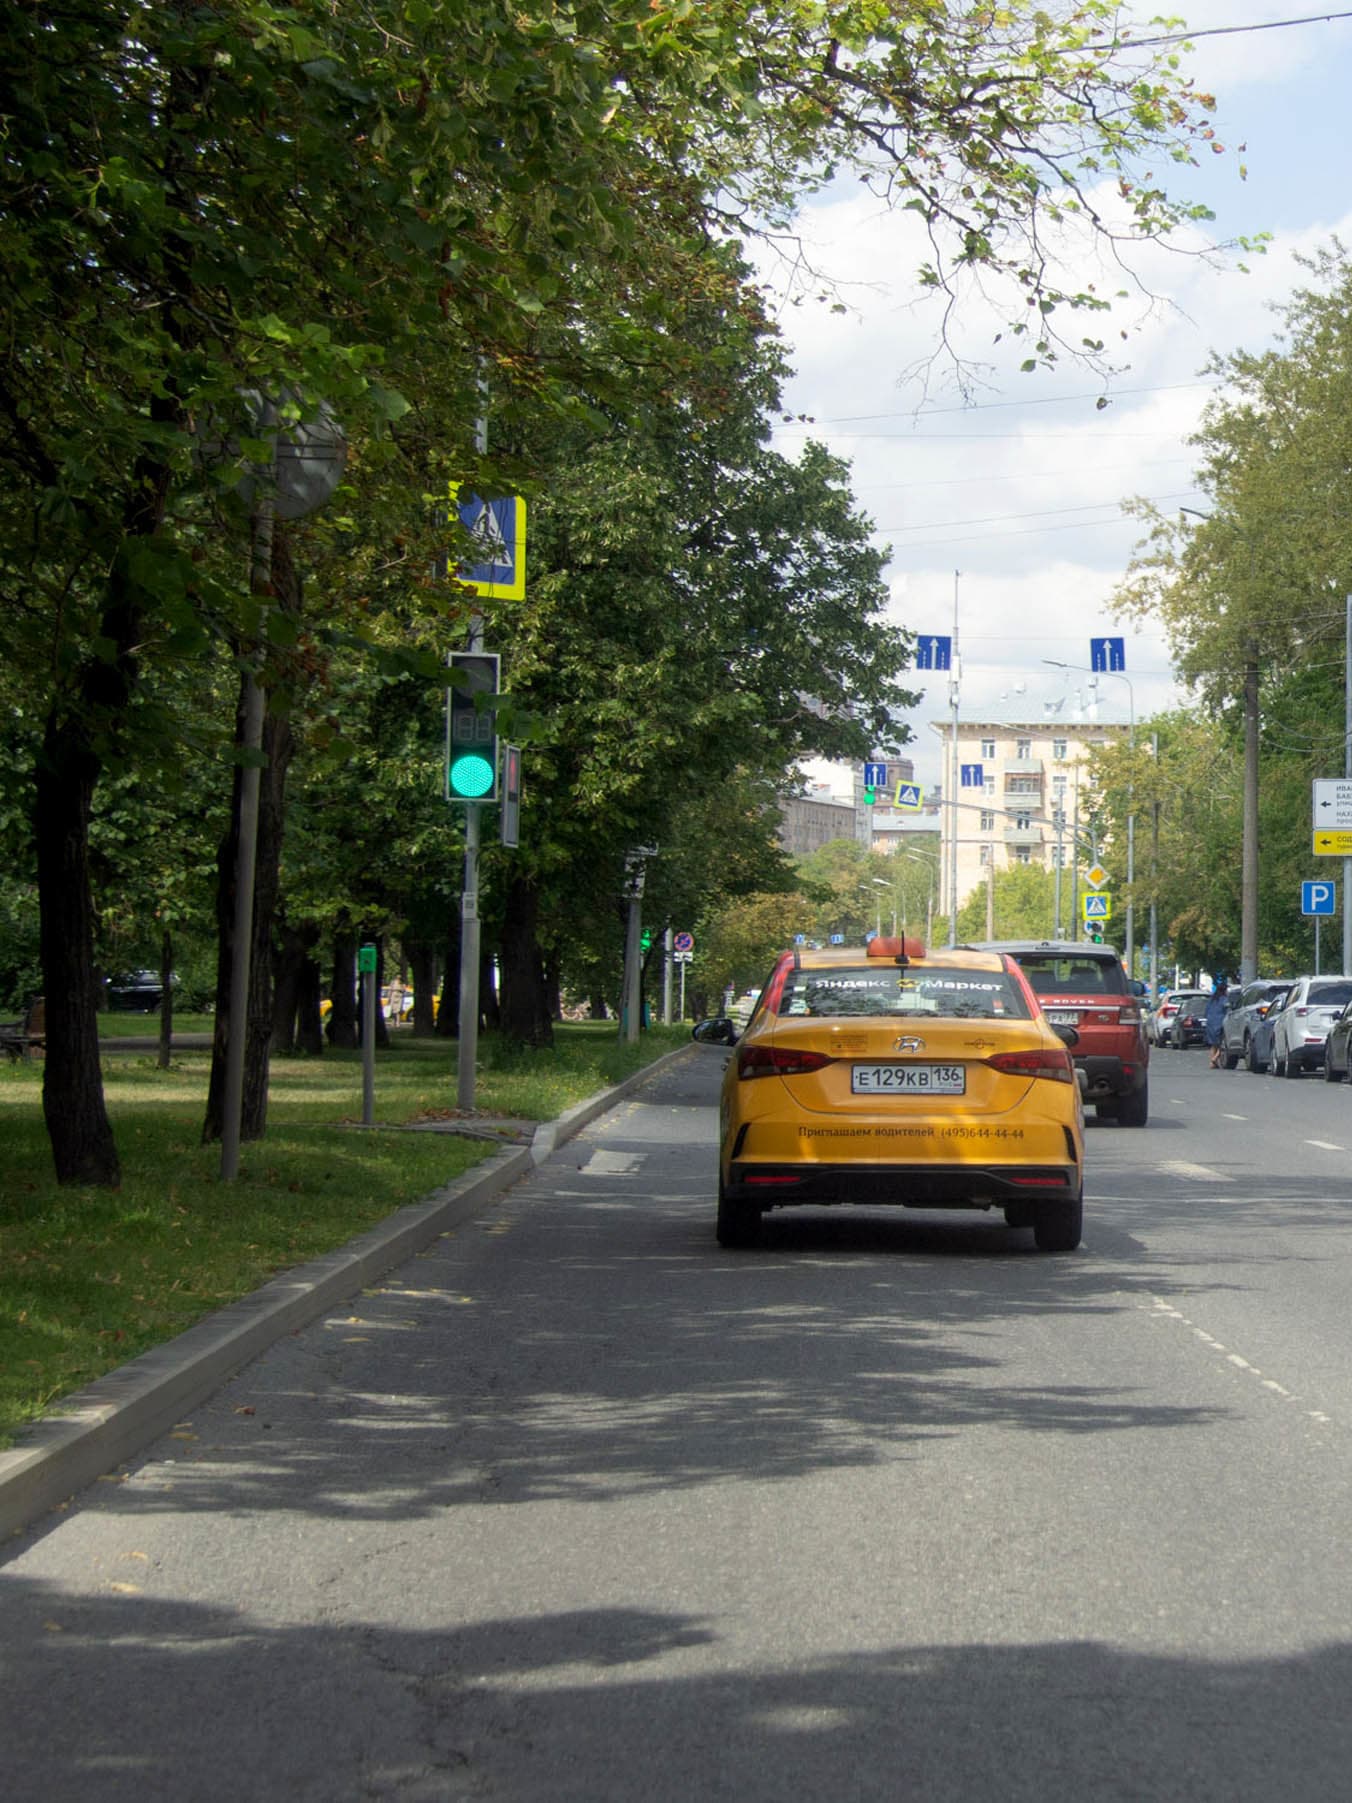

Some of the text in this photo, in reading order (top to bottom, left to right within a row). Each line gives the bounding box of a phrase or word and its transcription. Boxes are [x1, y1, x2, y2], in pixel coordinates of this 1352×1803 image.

[1311, 885, 1329, 910] P
[815, 979, 1004, 991] Яндекс Маркет
[934, 1067, 960, 1081] 136
[798, 1126, 1025, 1139] Приглашаем водителей (495)644-44-44
